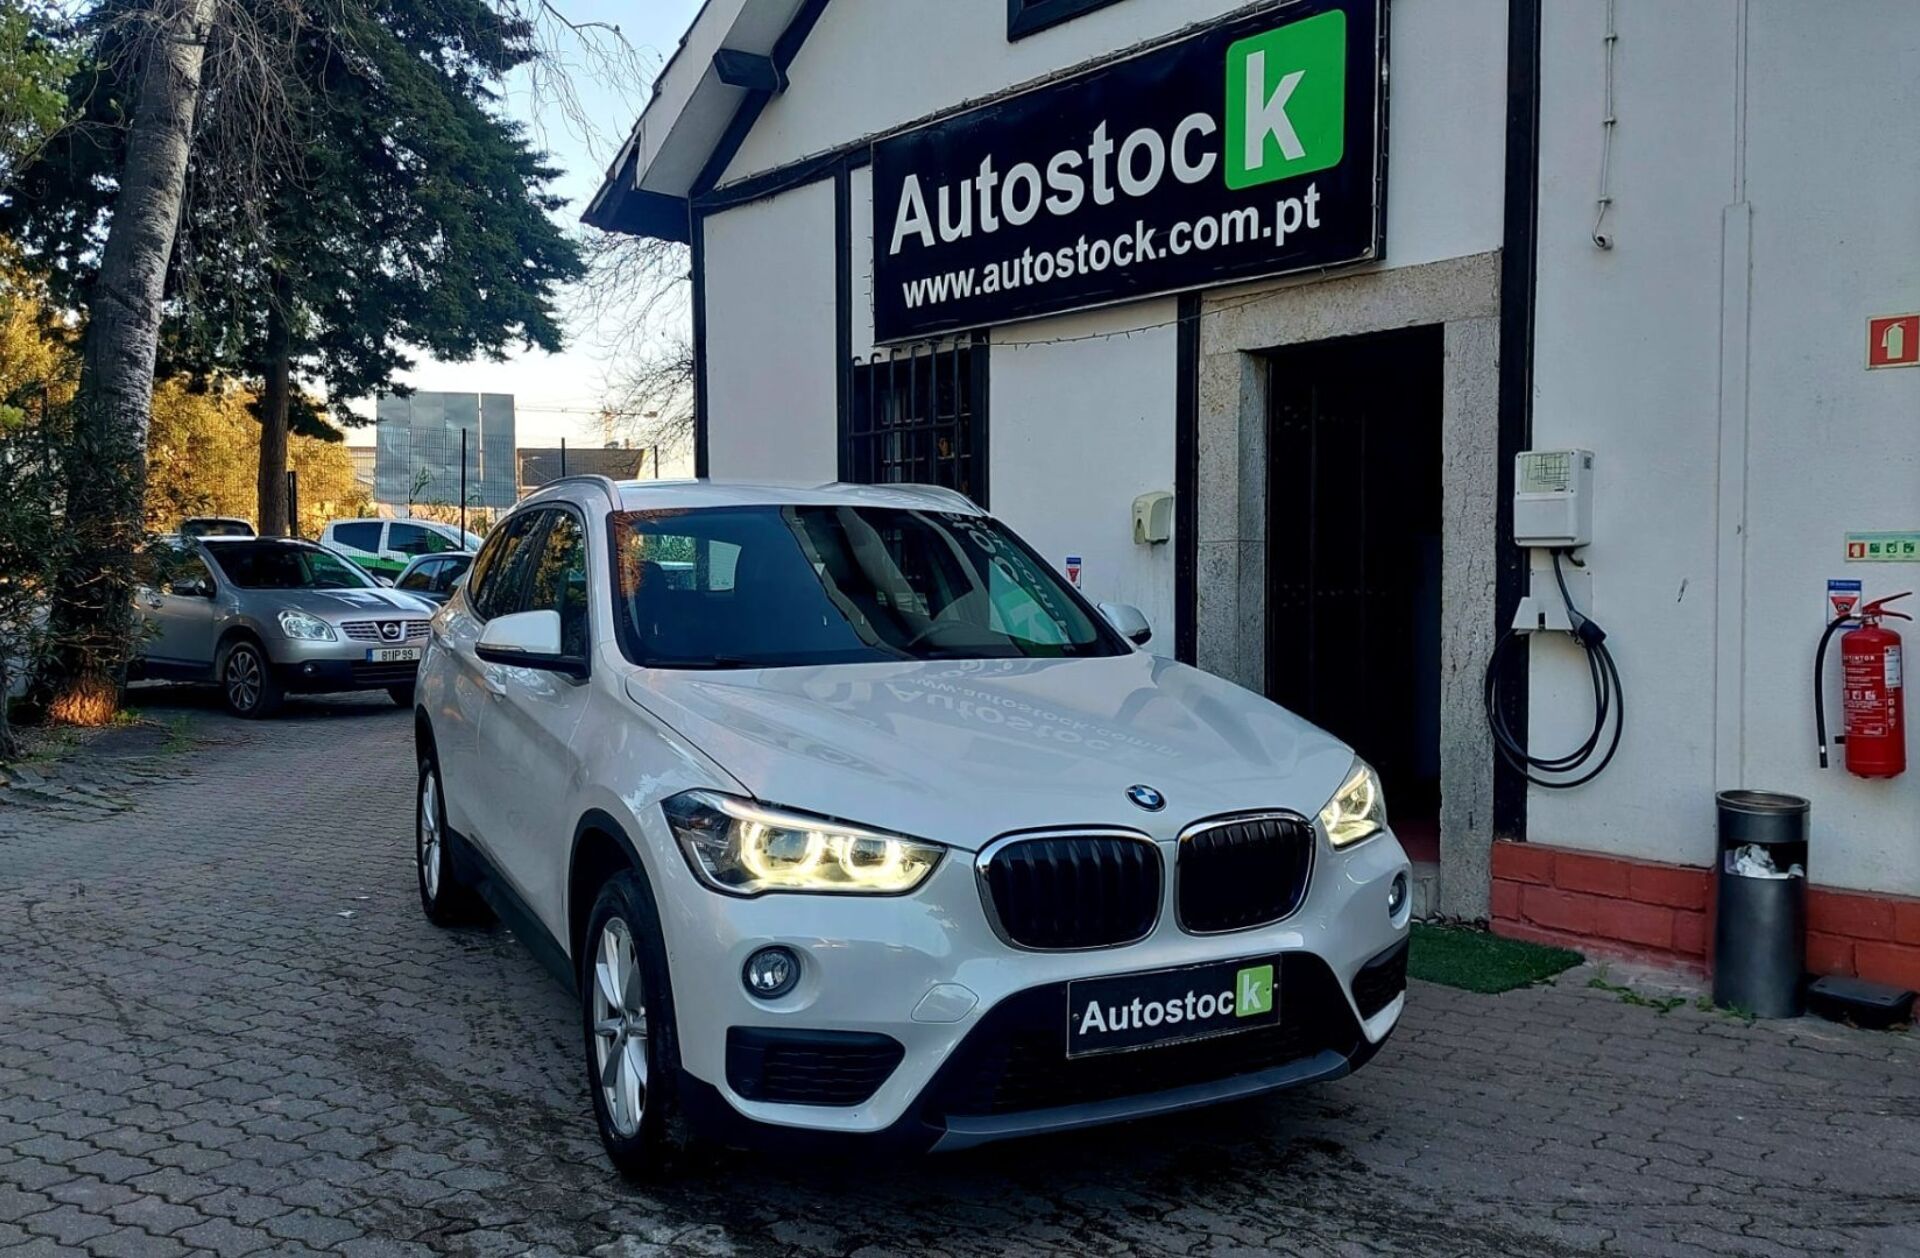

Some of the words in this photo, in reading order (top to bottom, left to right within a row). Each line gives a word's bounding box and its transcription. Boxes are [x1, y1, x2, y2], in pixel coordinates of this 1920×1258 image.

[889, 49, 1307, 255] Autostock
[902, 182, 1321, 309] www.autostock.com.pt
[1078, 973, 1263, 1036] Autostock
